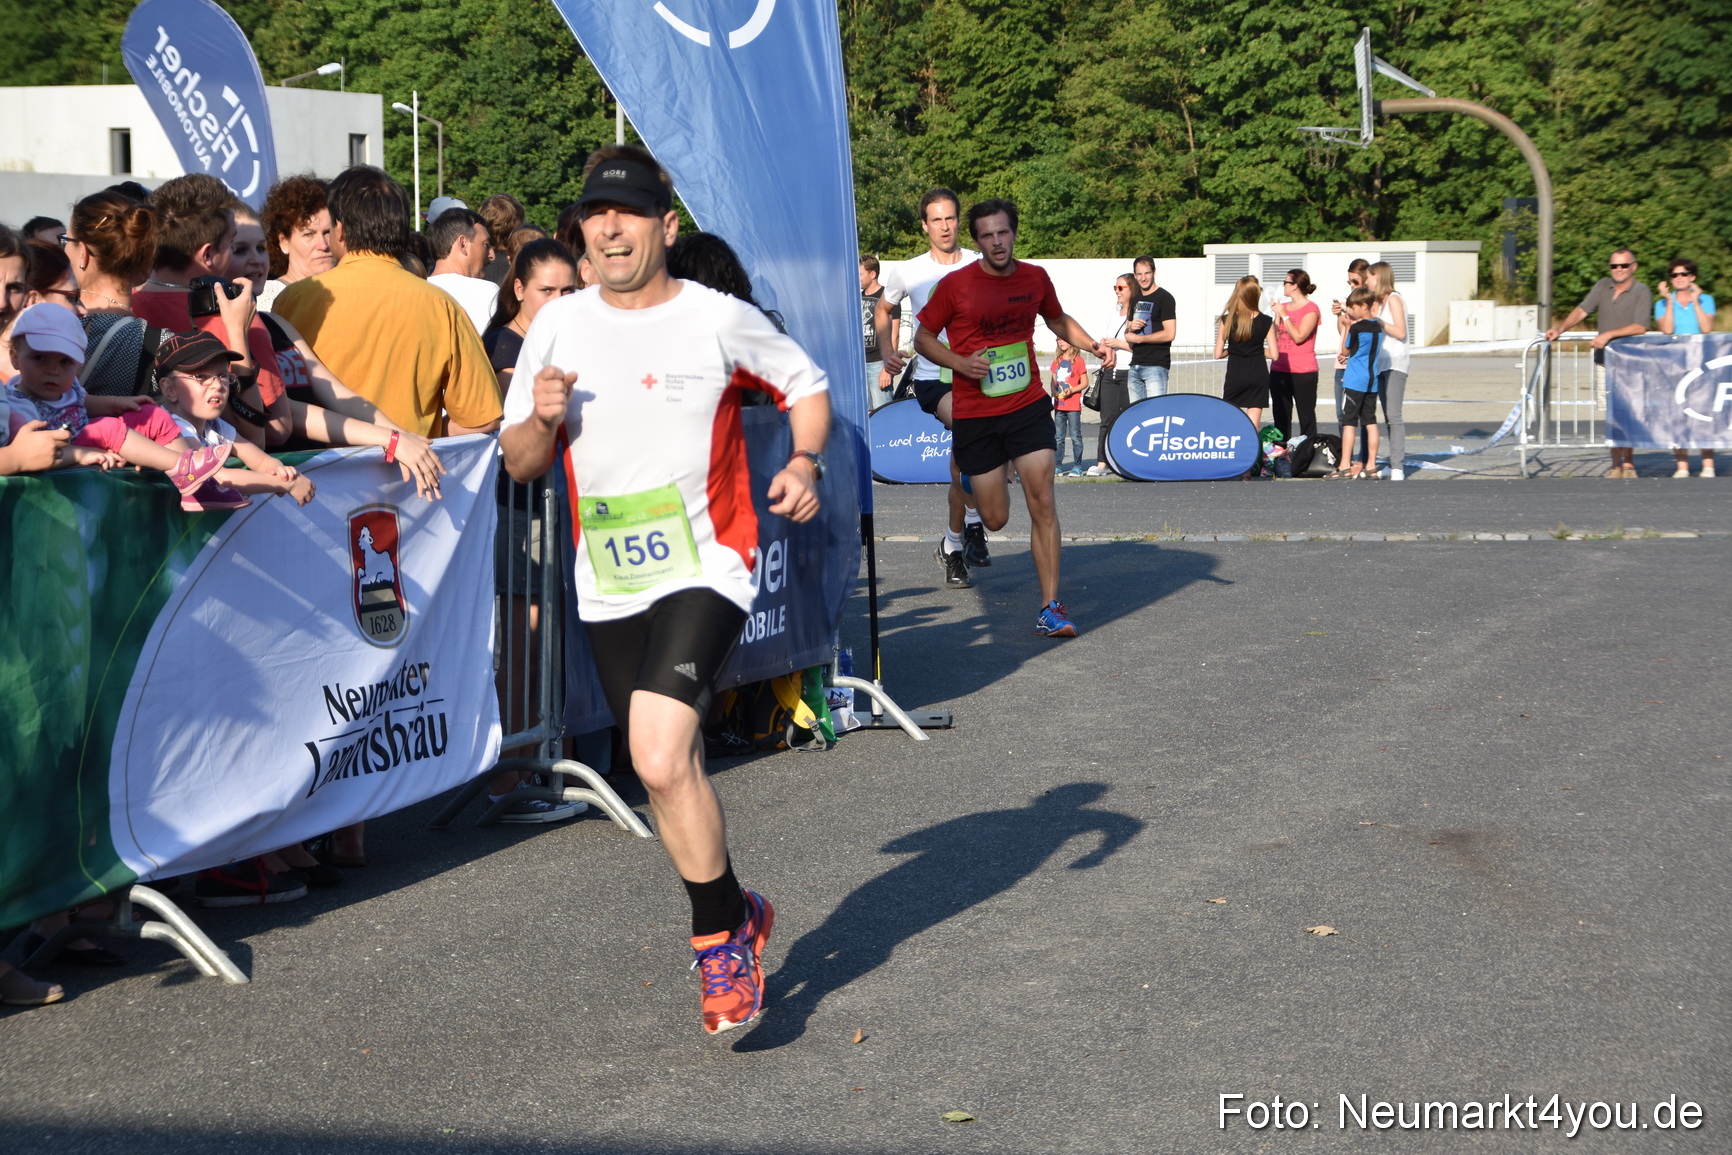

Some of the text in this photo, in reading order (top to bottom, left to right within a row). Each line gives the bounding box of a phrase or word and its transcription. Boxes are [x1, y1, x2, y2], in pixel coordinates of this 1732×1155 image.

[988, 361, 1026, 384] 1530
[889, 434, 912, 447] und
[916, 431, 938, 443] das
[1148, 431, 1241, 452] Fischer
[921, 446, 952, 462] fährt
[1158, 451, 1236, 462] AUTOMOBILE
[604, 530, 670, 567] 156
[369, 613, 397, 636] 1628
